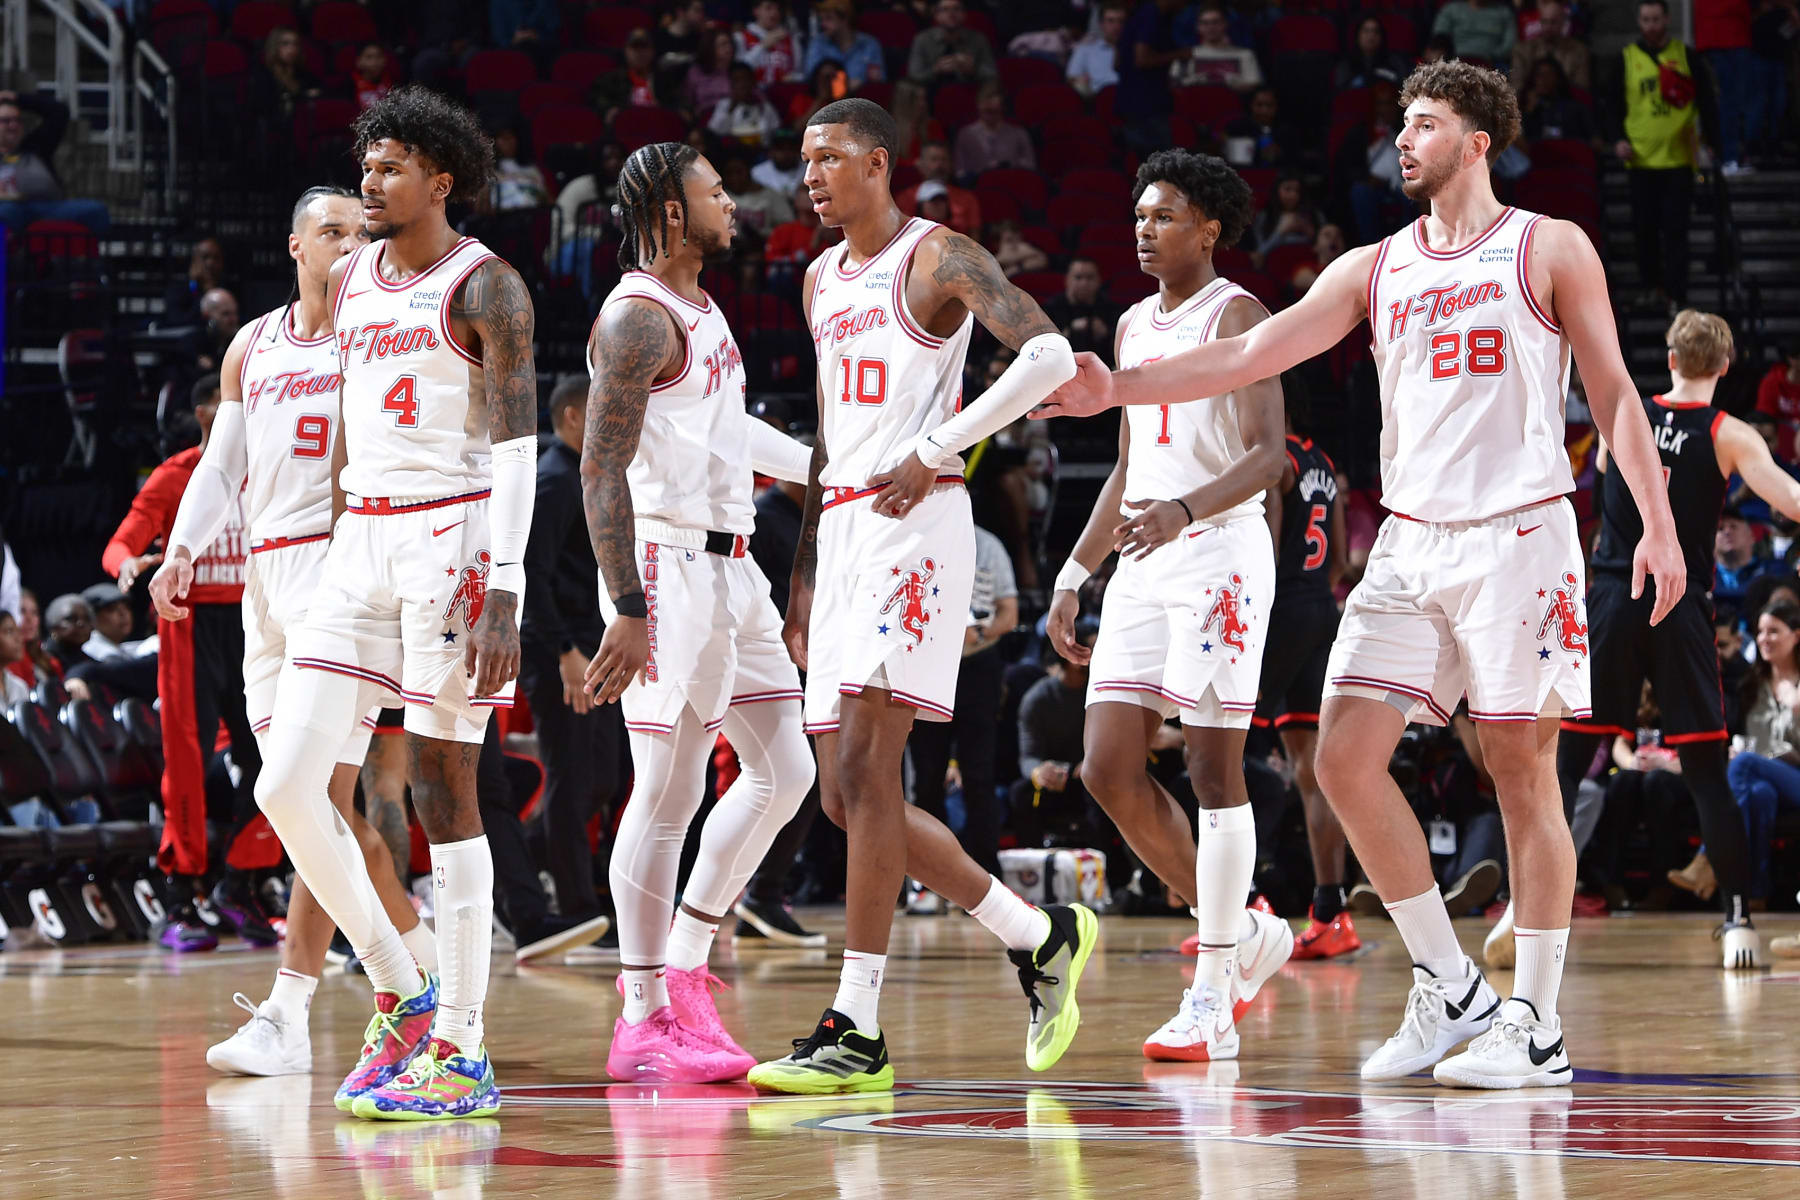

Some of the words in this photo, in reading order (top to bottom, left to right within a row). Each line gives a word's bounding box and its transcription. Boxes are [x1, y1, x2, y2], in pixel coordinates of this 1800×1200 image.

[1478, 254, 1513, 263] karma
[1482, 246, 1514, 255] credit
[409, 300, 439, 311] karma
[413, 290, 442, 301] credit
[1388, 279, 1507, 344] H-Town
[338, 318, 440, 371] H-Town
[812, 305, 889, 361] H-Town
[1429, 326, 1508, 382] 28
[381, 374, 421, 429] 4
[839, 355, 889, 407] 10
[290, 412, 333, 461] 9
[1155, 404, 1173, 447] 1
[1654, 424, 1690, 456] ICK
[1302, 503, 1329, 571] 5
[644, 541, 659, 683] ROCKETS
